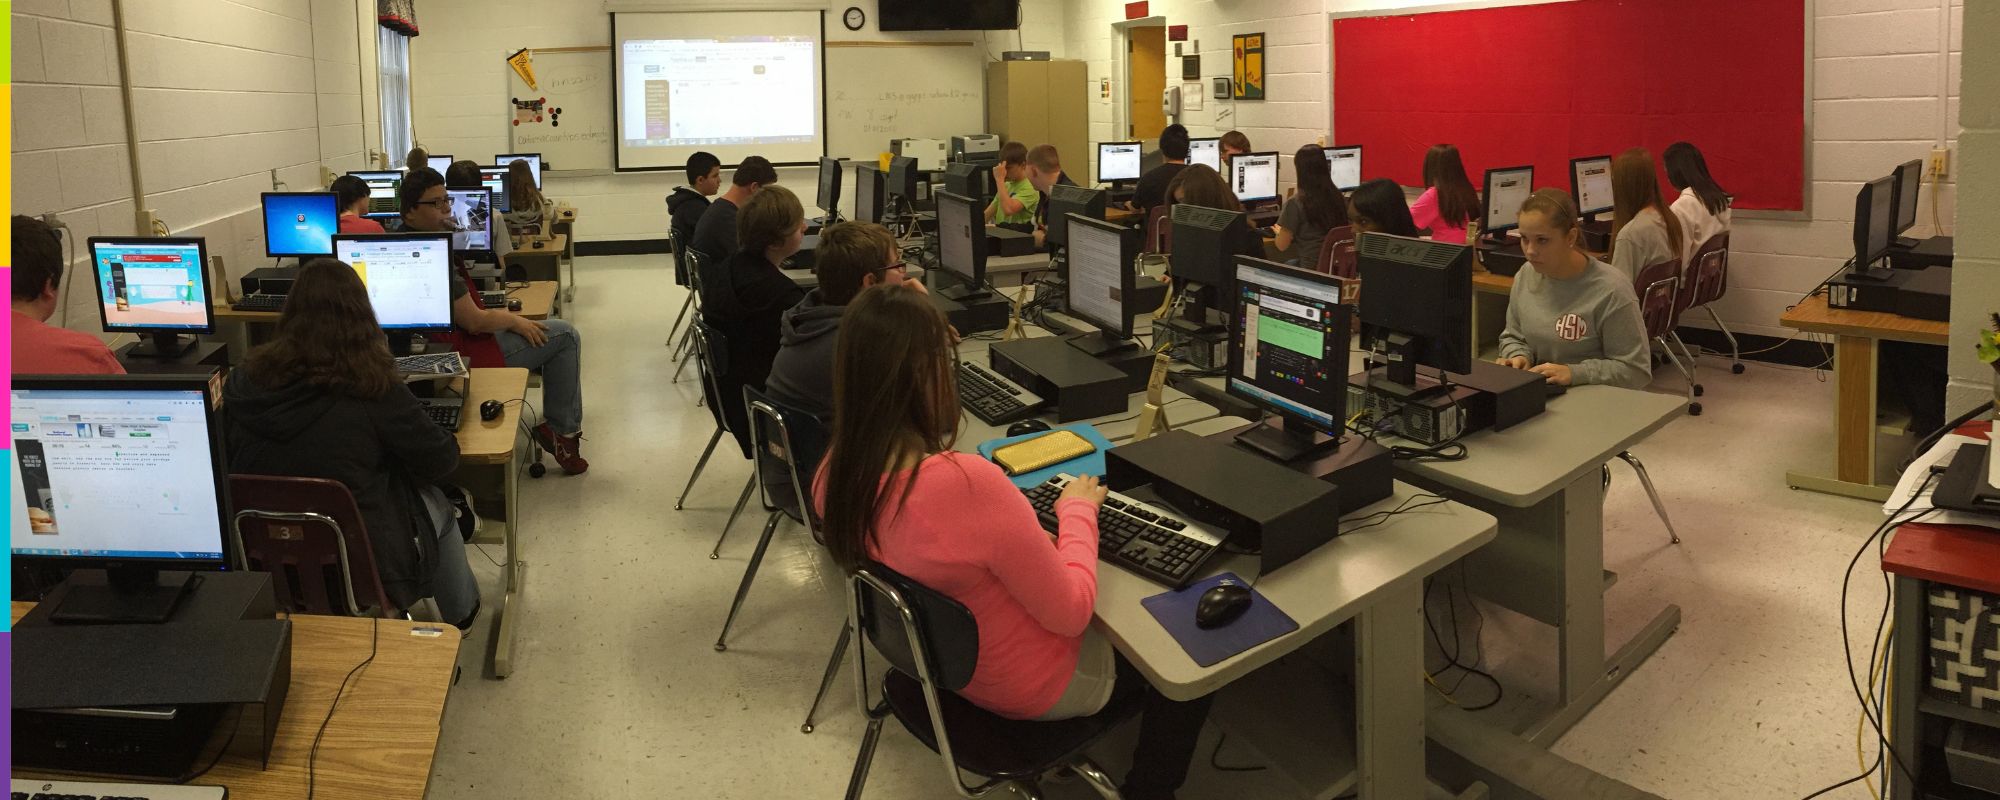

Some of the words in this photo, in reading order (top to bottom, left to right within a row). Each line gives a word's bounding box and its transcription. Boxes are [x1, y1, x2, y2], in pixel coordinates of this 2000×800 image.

[1343, 283, 1360, 300] 17
[1555, 313, 1587, 340] HSM
[280, 526, 291, 540] 3
